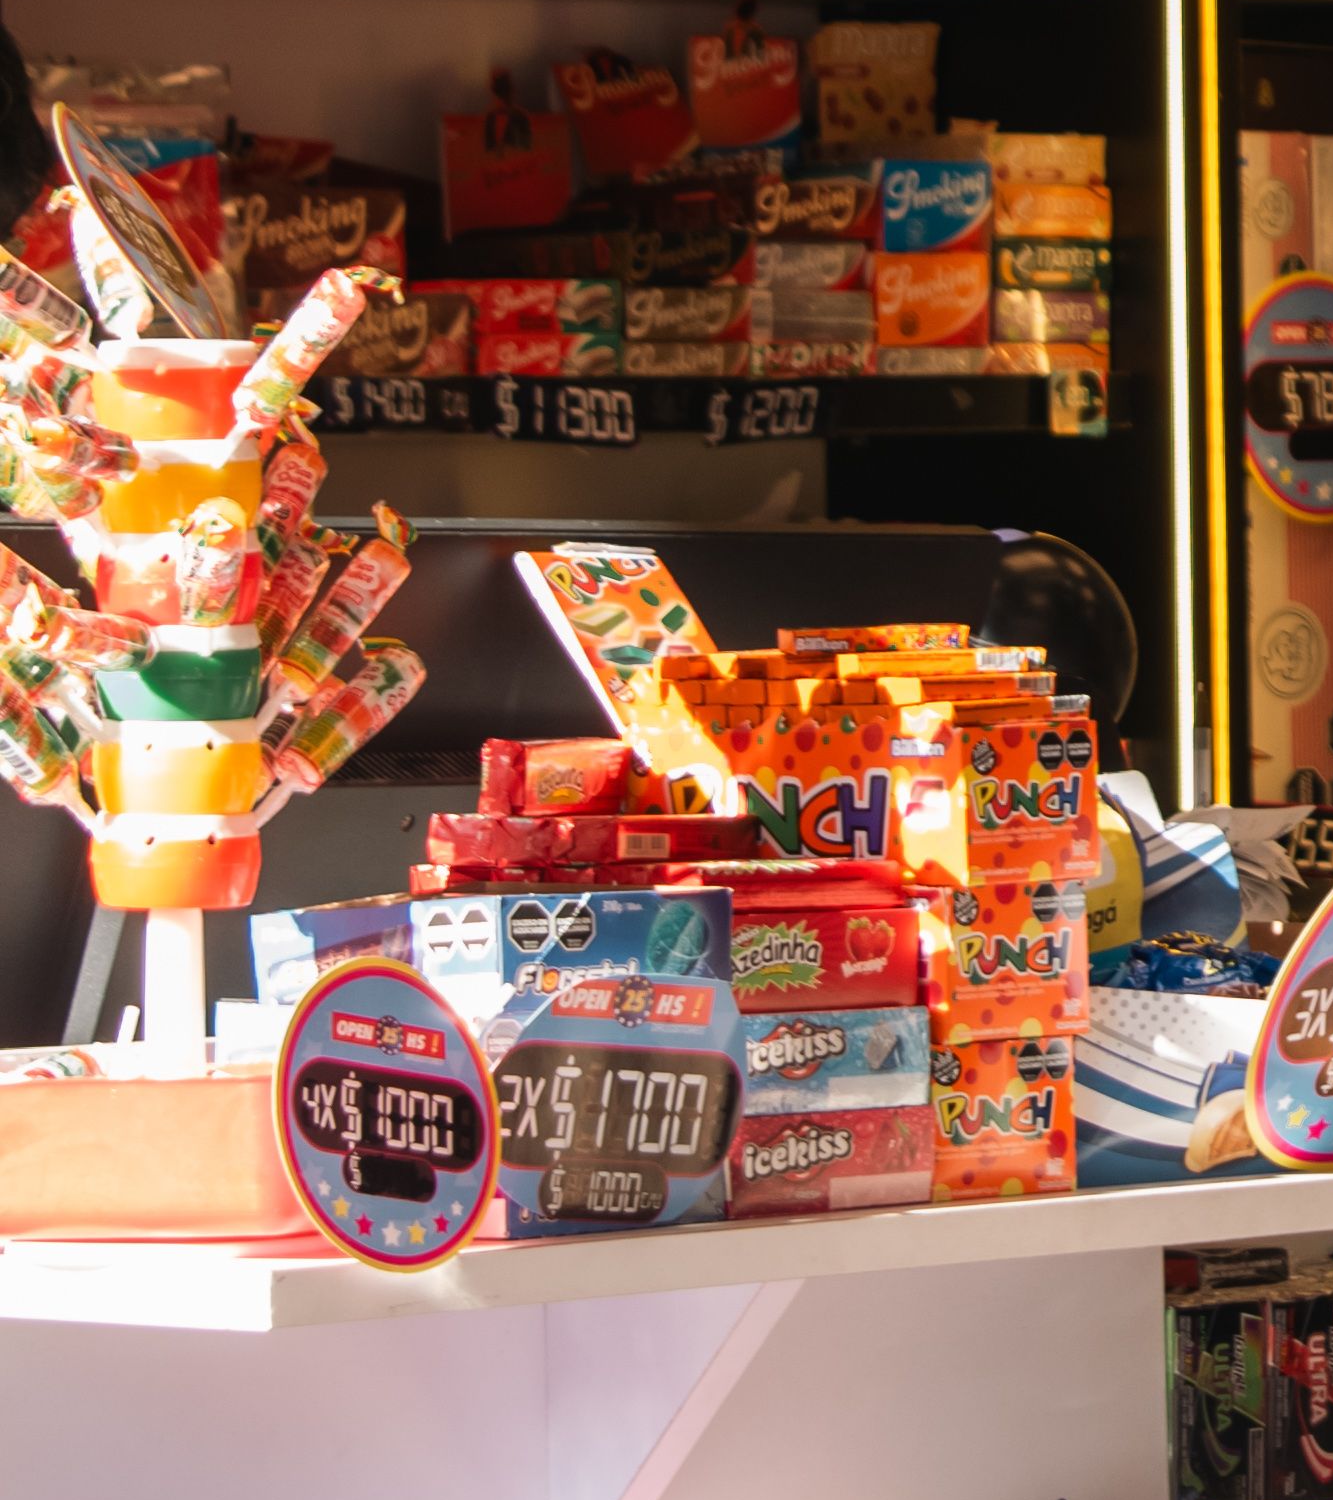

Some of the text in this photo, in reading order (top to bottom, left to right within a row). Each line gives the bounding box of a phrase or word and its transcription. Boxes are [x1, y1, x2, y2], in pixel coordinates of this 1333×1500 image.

[753, 180, 858, 235] Smoking
[886, 167, 988, 222] Smoking
[625, 287, 732, 340] Smoking
[879, 263, 983, 315] Smoking
[971, 771, 1083, 823] PUNCH
[731, 930, 824, 977] Azedinha
[957, 926, 1073, 979] PUNCH
[558, 987, 613, 1011] OPEN
[656, 994, 687, 1016] HS
[335, 1018, 375, 1044] OPEN
[405, 1031, 427, 1052] HS
[936, 1086, 1056, 1139] PUNCH
[743, 1127, 854, 1183] icekiss
[1210, 1340, 1231, 1434] ULTRA
[1309, 1332, 1328, 1427] ULTRA
